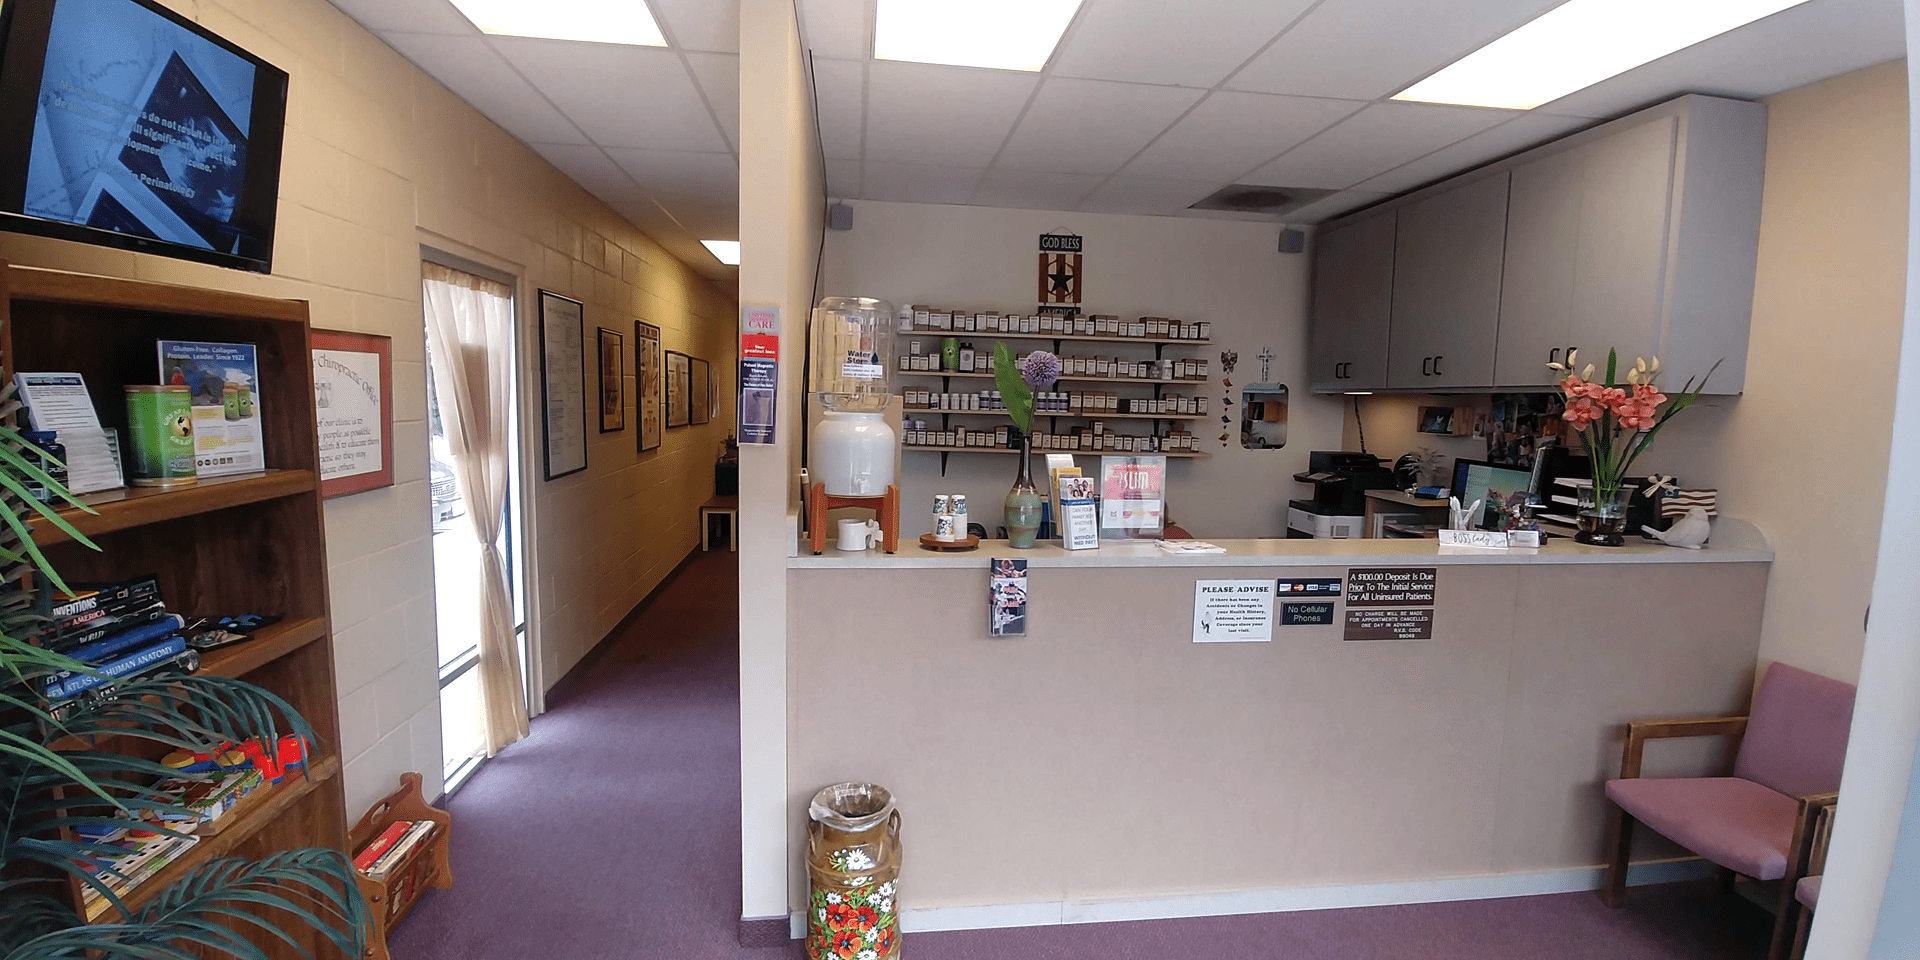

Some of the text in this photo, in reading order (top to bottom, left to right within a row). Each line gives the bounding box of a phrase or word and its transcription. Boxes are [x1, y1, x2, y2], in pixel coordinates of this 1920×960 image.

[148, 112, 160, 123] do
[162, 119, 176, 130] not
[1042, 236, 1080, 249] GOD BLESS
[847, 356, 868, 364] Store
[848, 350, 870, 358] Water
[318, 354, 362, 386] Chiropractic
[1385, 573, 1411, 583] Deposit
[1348, 583, 1364, 591] Prior
[1366, 583, 1375, 591] To
[1371, 592, 1404, 600] Uninsured
[1406, 592, 1433, 600] Patients.
[52, 597, 97, 616] INVENTIONS
[72, 610, 106, 626] AMERICA
[67, 676, 93, 694] ATLAS
[106, 660, 137, 677] HUMAN
[137, 646, 173, 664] ANATOMY
